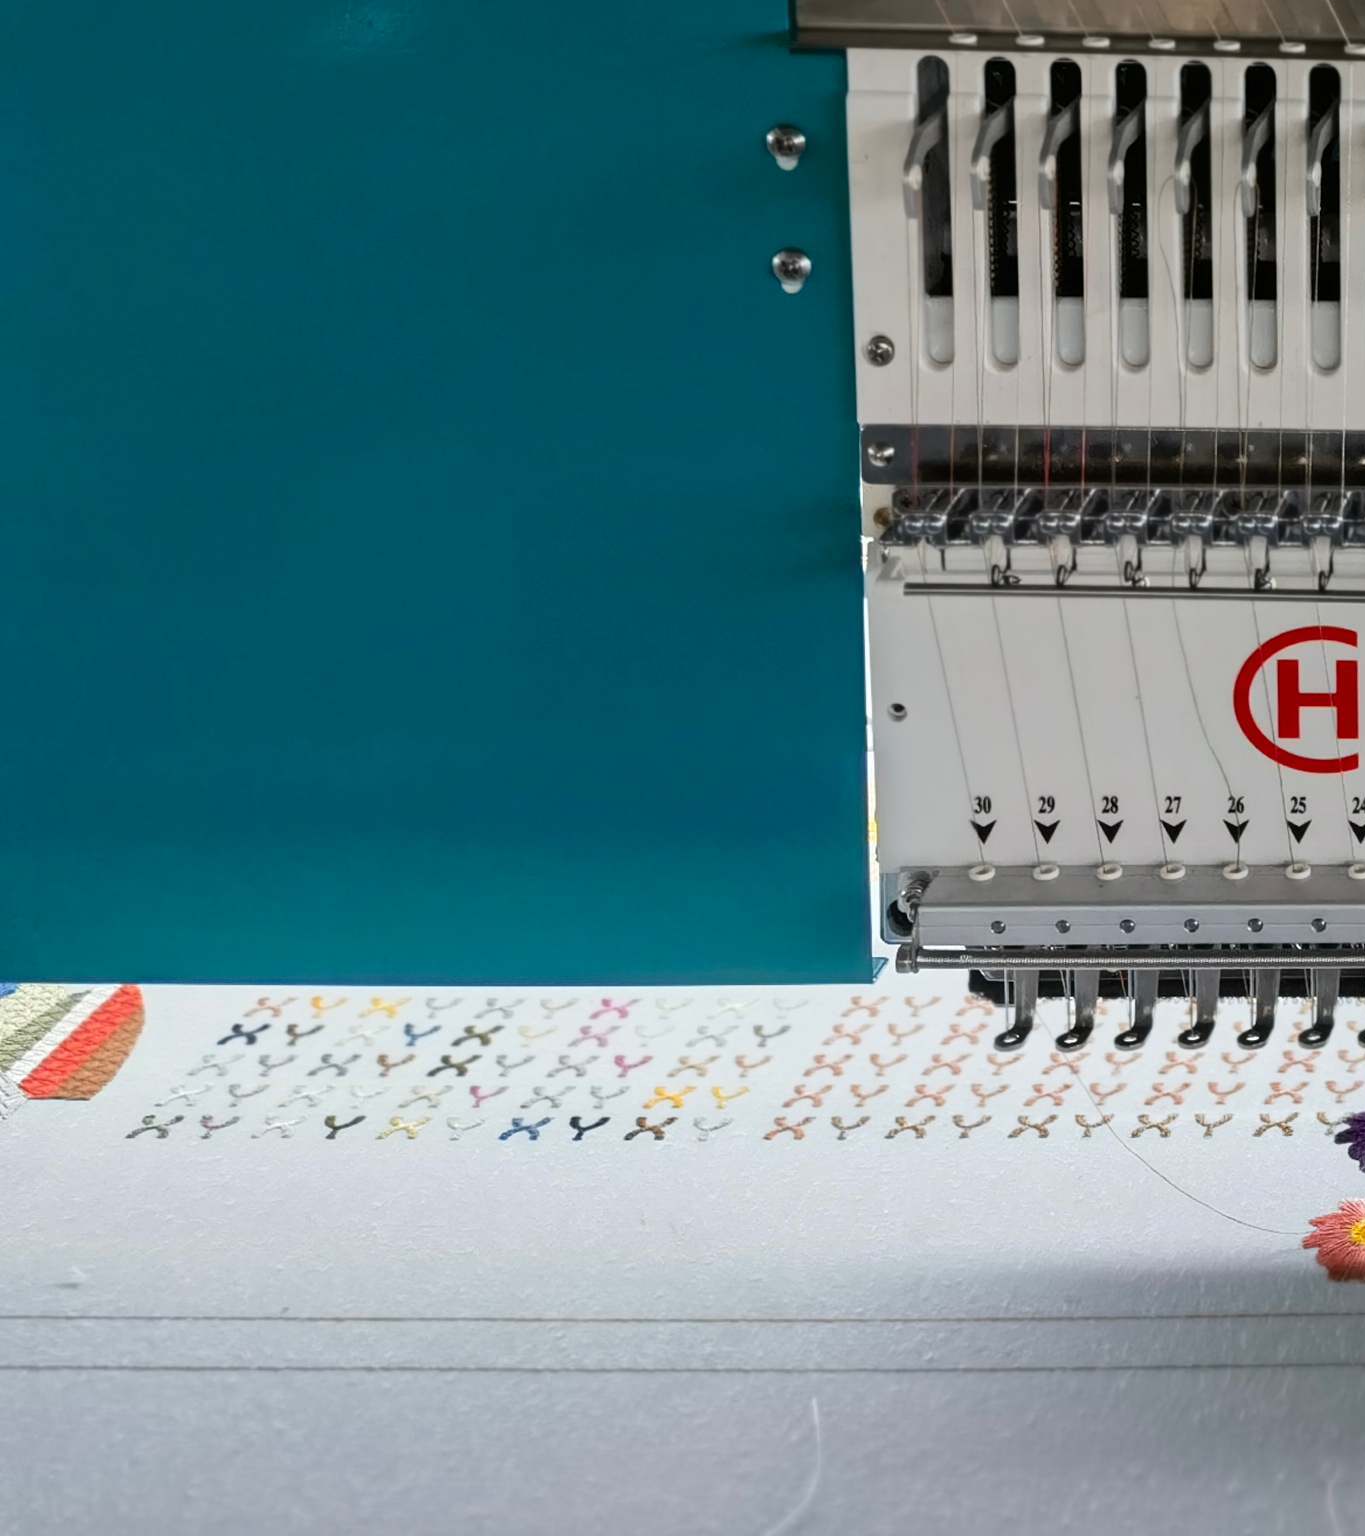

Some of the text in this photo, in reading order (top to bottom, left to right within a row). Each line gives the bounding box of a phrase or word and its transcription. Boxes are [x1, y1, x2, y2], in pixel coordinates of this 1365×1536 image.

[974, 796, 992, 814] 30
[1038, 796, 1055, 814] 29
[1102, 796, 1119, 814] 28
[1165, 796, 1182, 814] 27
[1228, 796, 1244, 814] 26
[1290, 796, 1307, 814] 25
